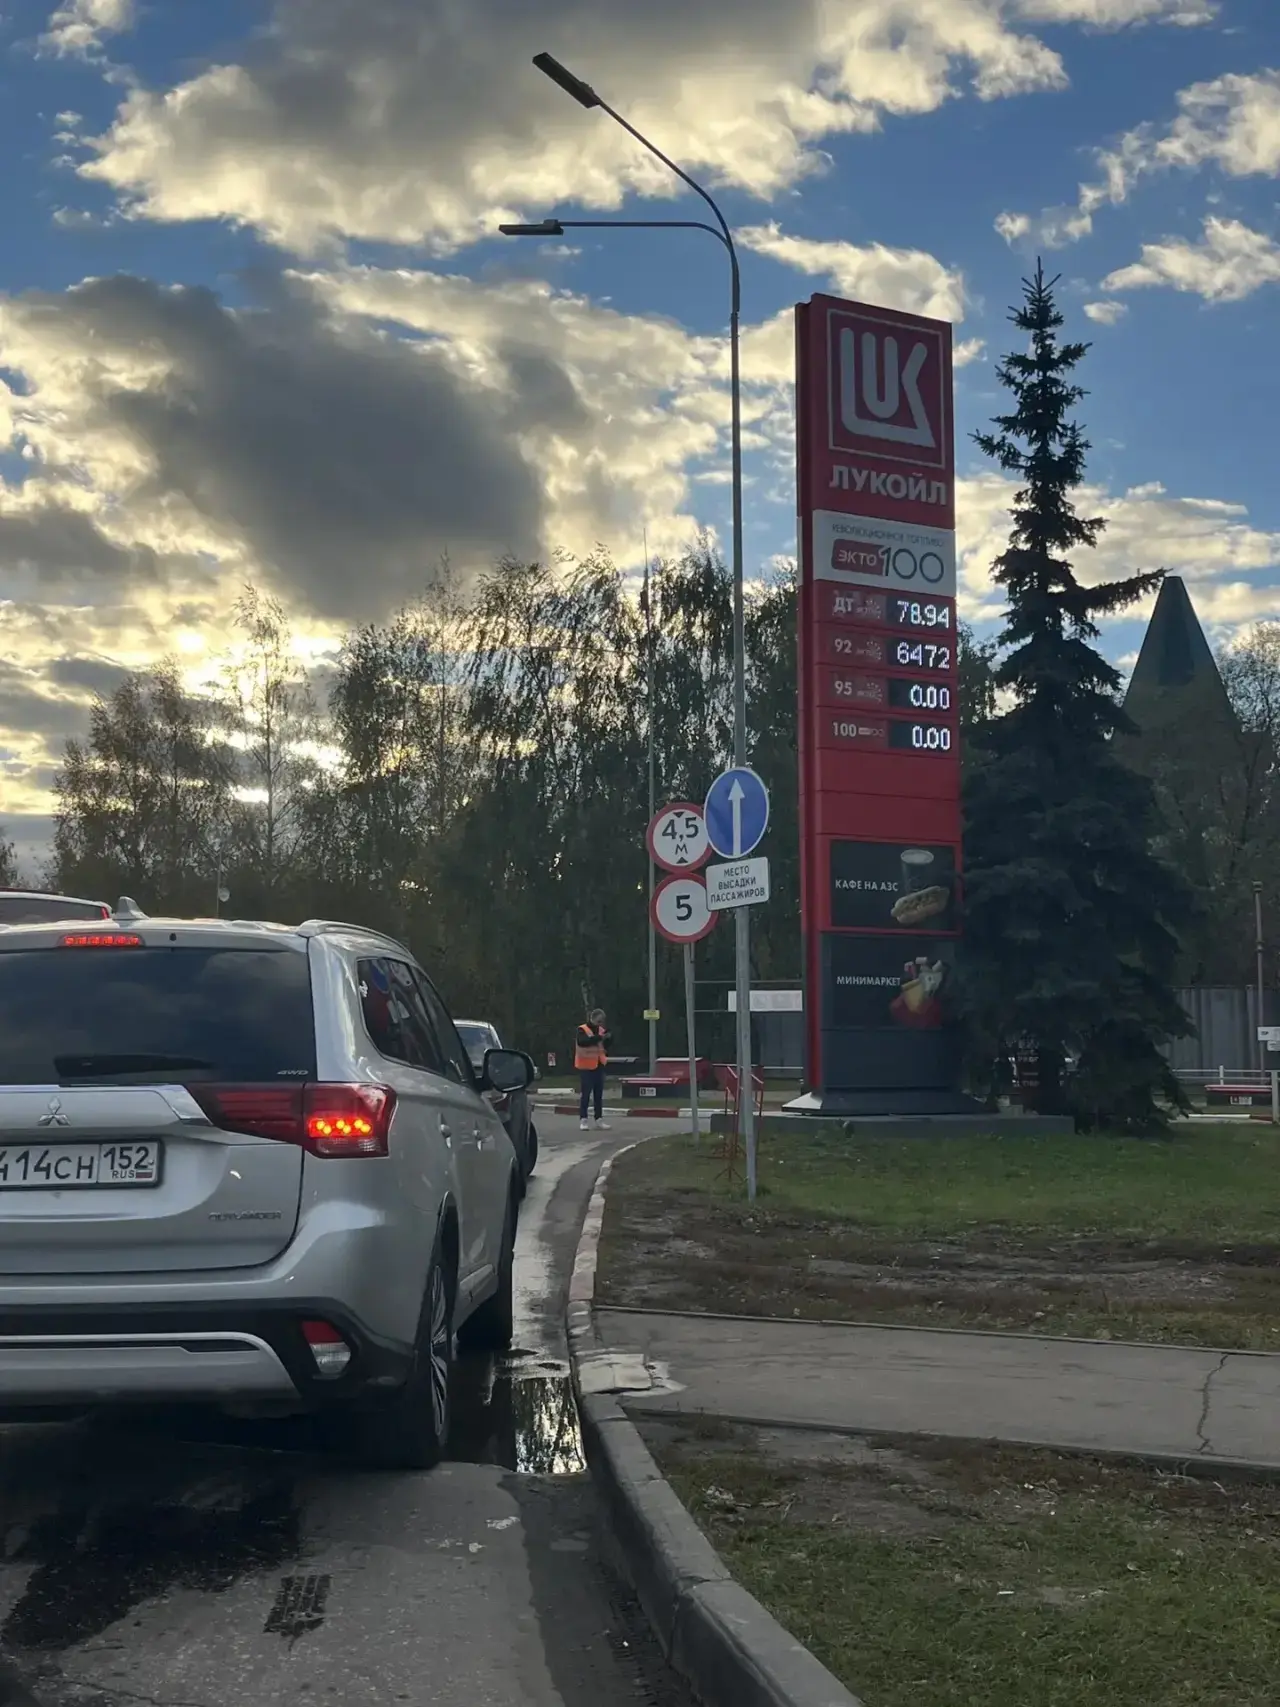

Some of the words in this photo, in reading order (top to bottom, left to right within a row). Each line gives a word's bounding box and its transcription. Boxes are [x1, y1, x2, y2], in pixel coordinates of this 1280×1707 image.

[829, 464, 947, 505] ЛУКОЙЛ
[838, 550, 877, 566] ЭКТО
[881, 546, 944, 583] 100
[832, 597, 854, 616] ДТ
[897, 600, 949, 628] 78.94
[834, 638, 852, 654] 92
[834, 680, 852, 696] 95
[910, 684, 950, 709] 0.00
[832, 722, 857, 737] 100
[912, 725, 950, 750] 0.00
[661, 816, 699, 842] 4,5
[718, 876, 757, 891] ВЫСАДКИ
[723, 865, 750, 878] МЕСТО
[710, 887, 766, 904] ПАССАЖИРОВ
[835, 879, 862, 890] КАФЕ
[864, 881, 878, 891] НА
[880, 881, 899, 892] АЗС
[675, 894, 693, 921] 5
[836, 975, 901, 986] МИНИМАРКЕТ
[103, 1146, 149, 1171] 152
[112, 1170, 136, 1180] RUS
